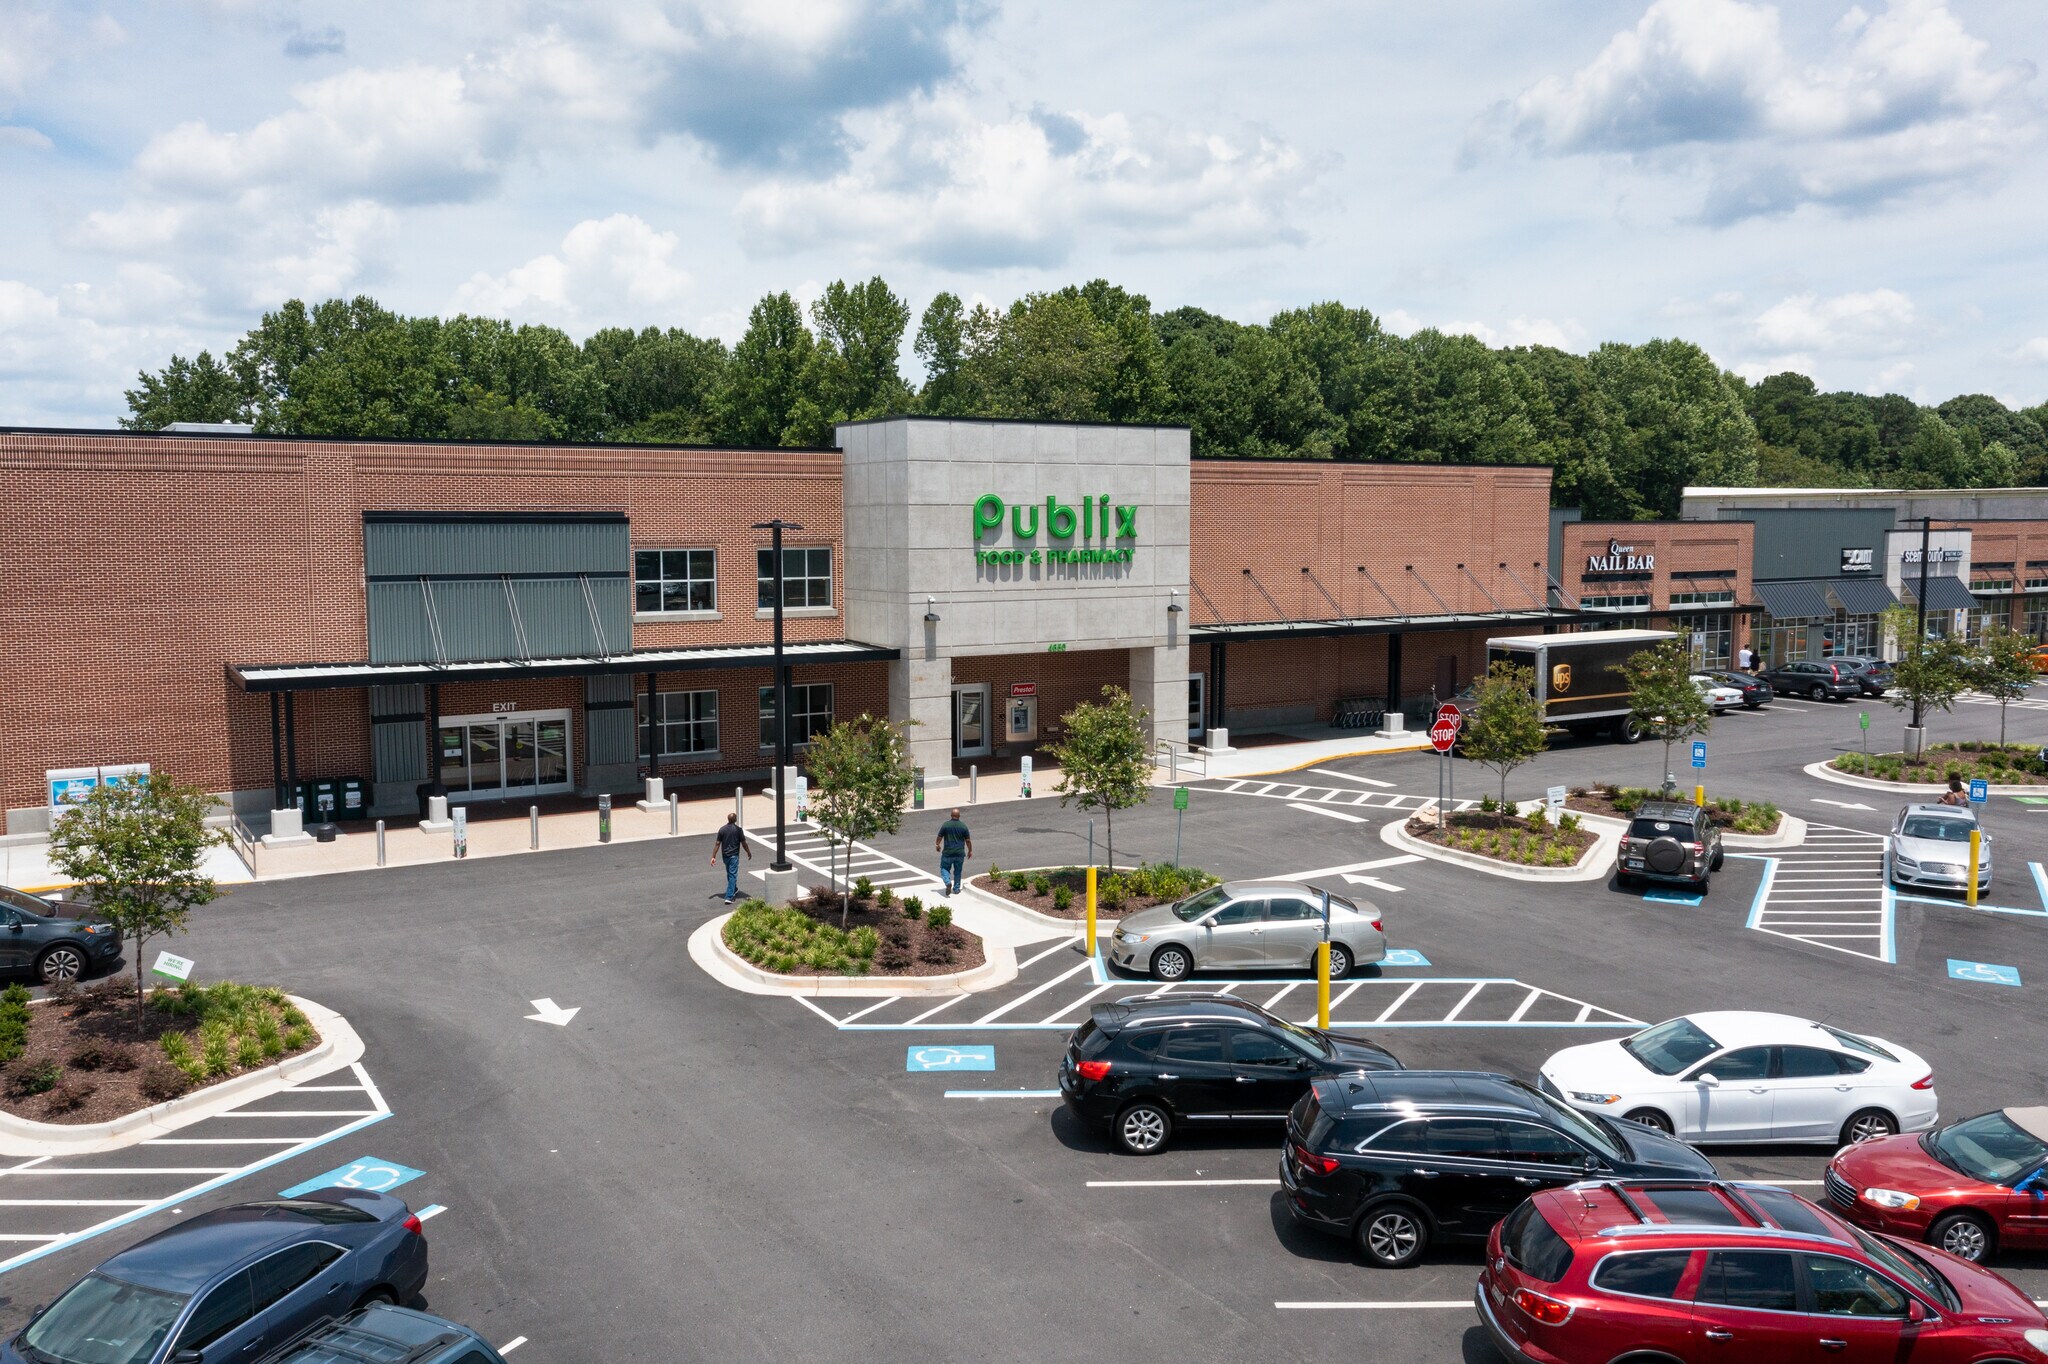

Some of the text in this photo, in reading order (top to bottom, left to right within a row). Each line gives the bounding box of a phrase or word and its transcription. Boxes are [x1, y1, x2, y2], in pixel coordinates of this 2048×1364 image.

[973, 494, 1138, 539] Publix
[1611, 543, 1634, 555] Queen
[976, 548, 1135, 566] FOOD & PHARMACY
[1905, 550, 1943, 562] scenound
[1589, 555, 1654, 571] NAIL BAR
[1555, 672, 1569, 688] ups
[1013, 685, 1034, 693] Presto!
[492, 702, 517, 711] EXIT
[1433, 729, 1454, 742] STOP
